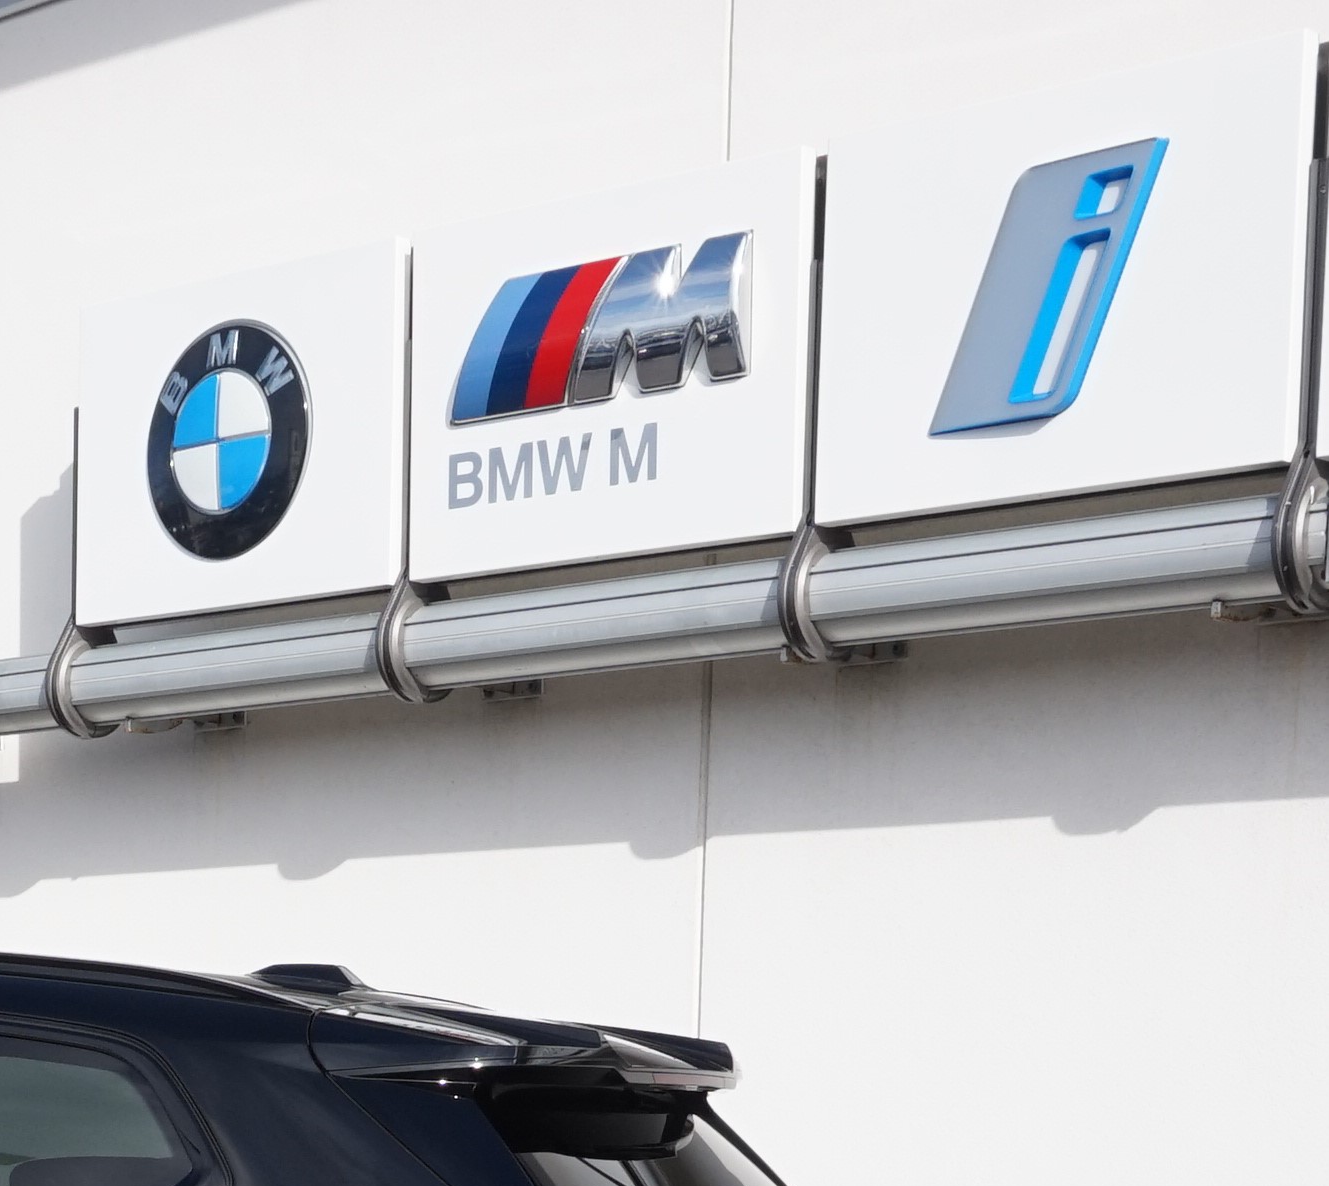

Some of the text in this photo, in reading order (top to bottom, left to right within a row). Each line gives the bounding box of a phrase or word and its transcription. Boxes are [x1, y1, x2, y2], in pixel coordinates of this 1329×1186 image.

[160, 328, 295, 415] BMW
[448, 422, 658, 509] BMW M
